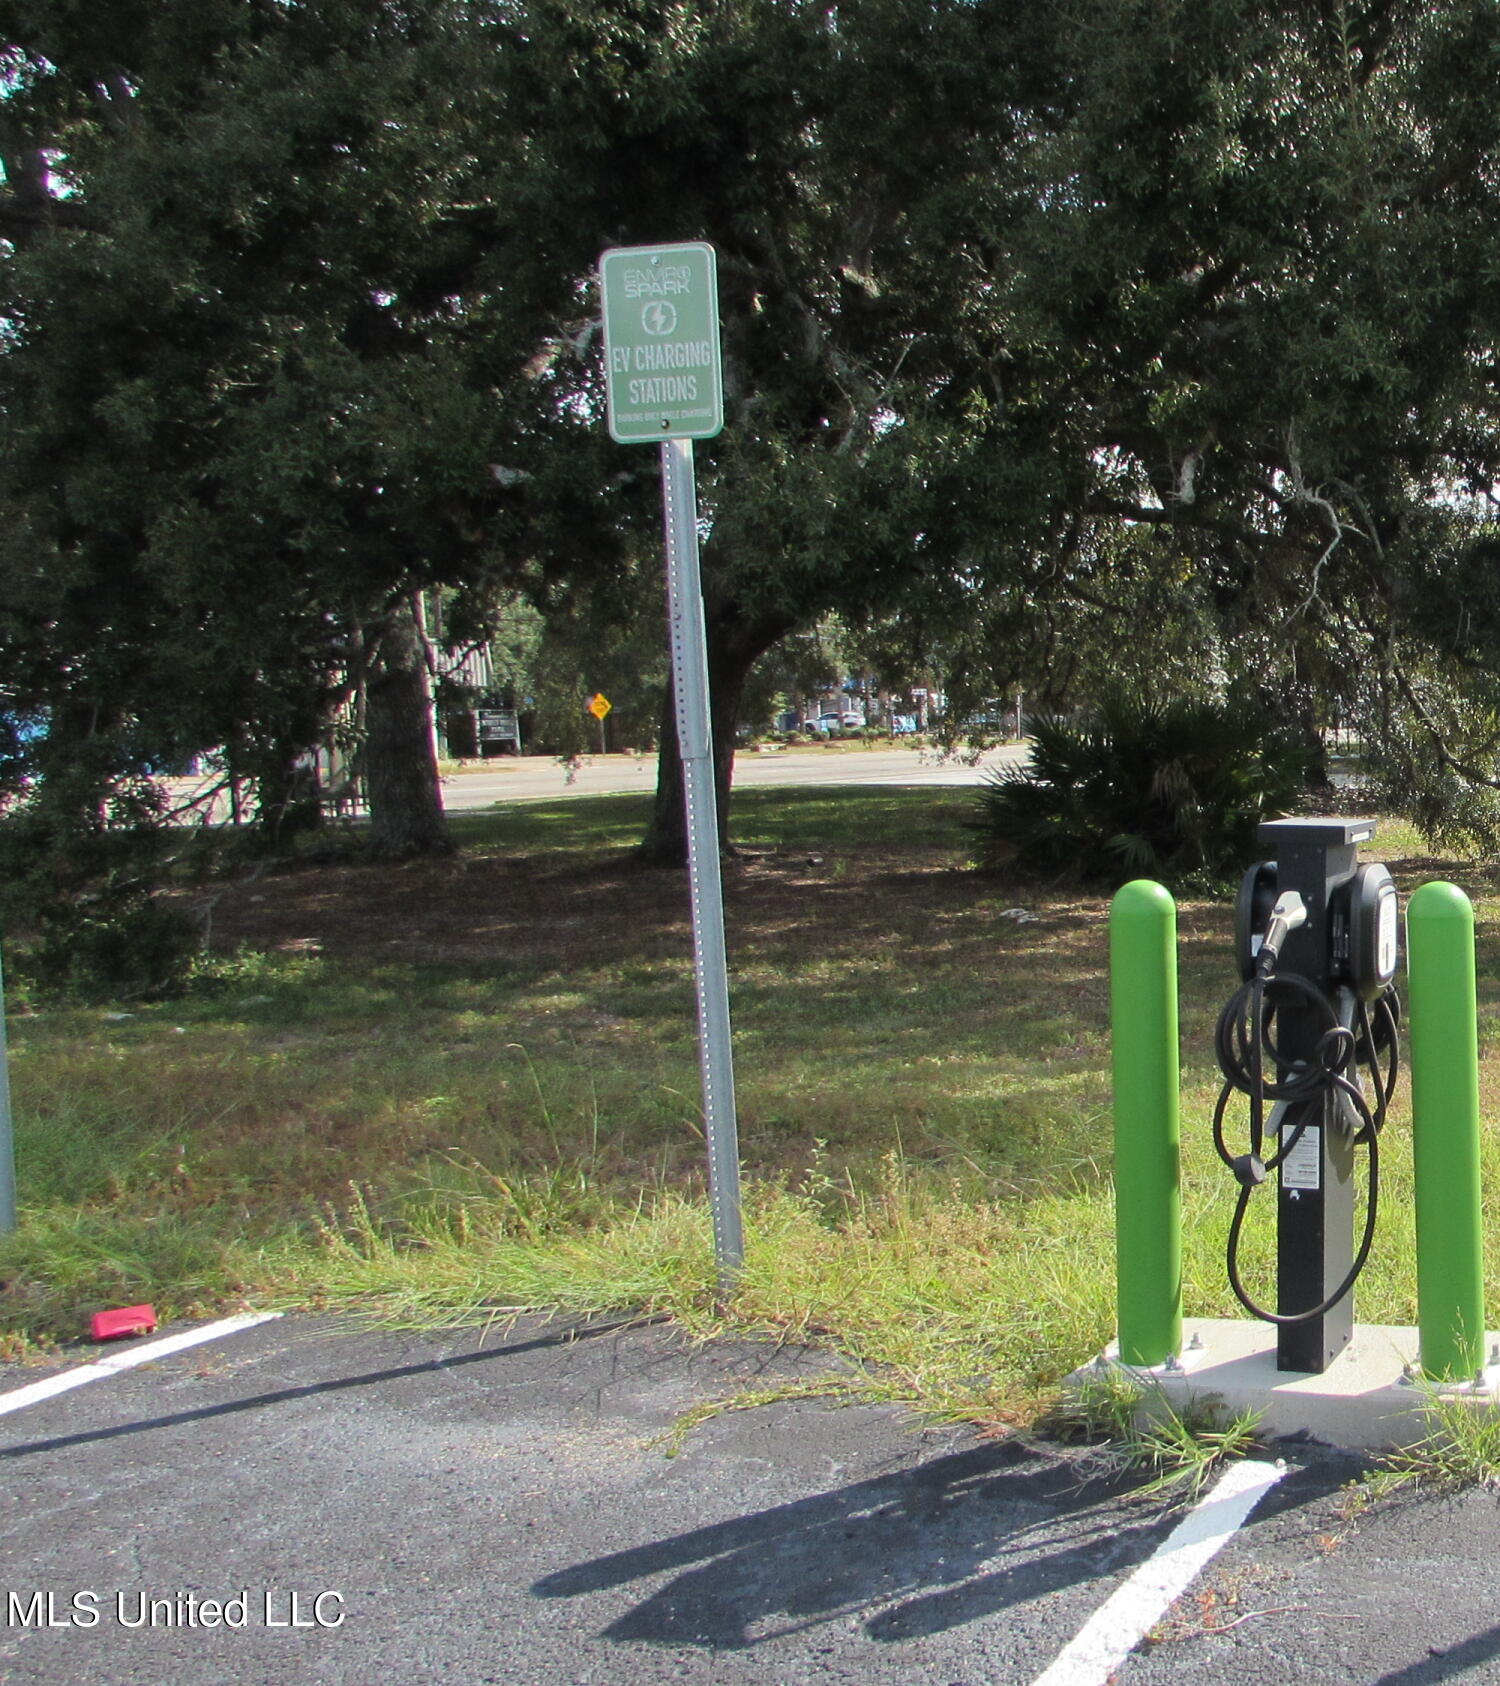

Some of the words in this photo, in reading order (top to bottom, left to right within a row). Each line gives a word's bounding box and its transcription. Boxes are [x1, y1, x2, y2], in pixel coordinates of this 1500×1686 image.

[624, 281, 690, 298] SPARK
[613, 347, 631, 373] EV
[635, 340, 711, 371] CHARGING
[629, 375, 697, 404] STATIONS
